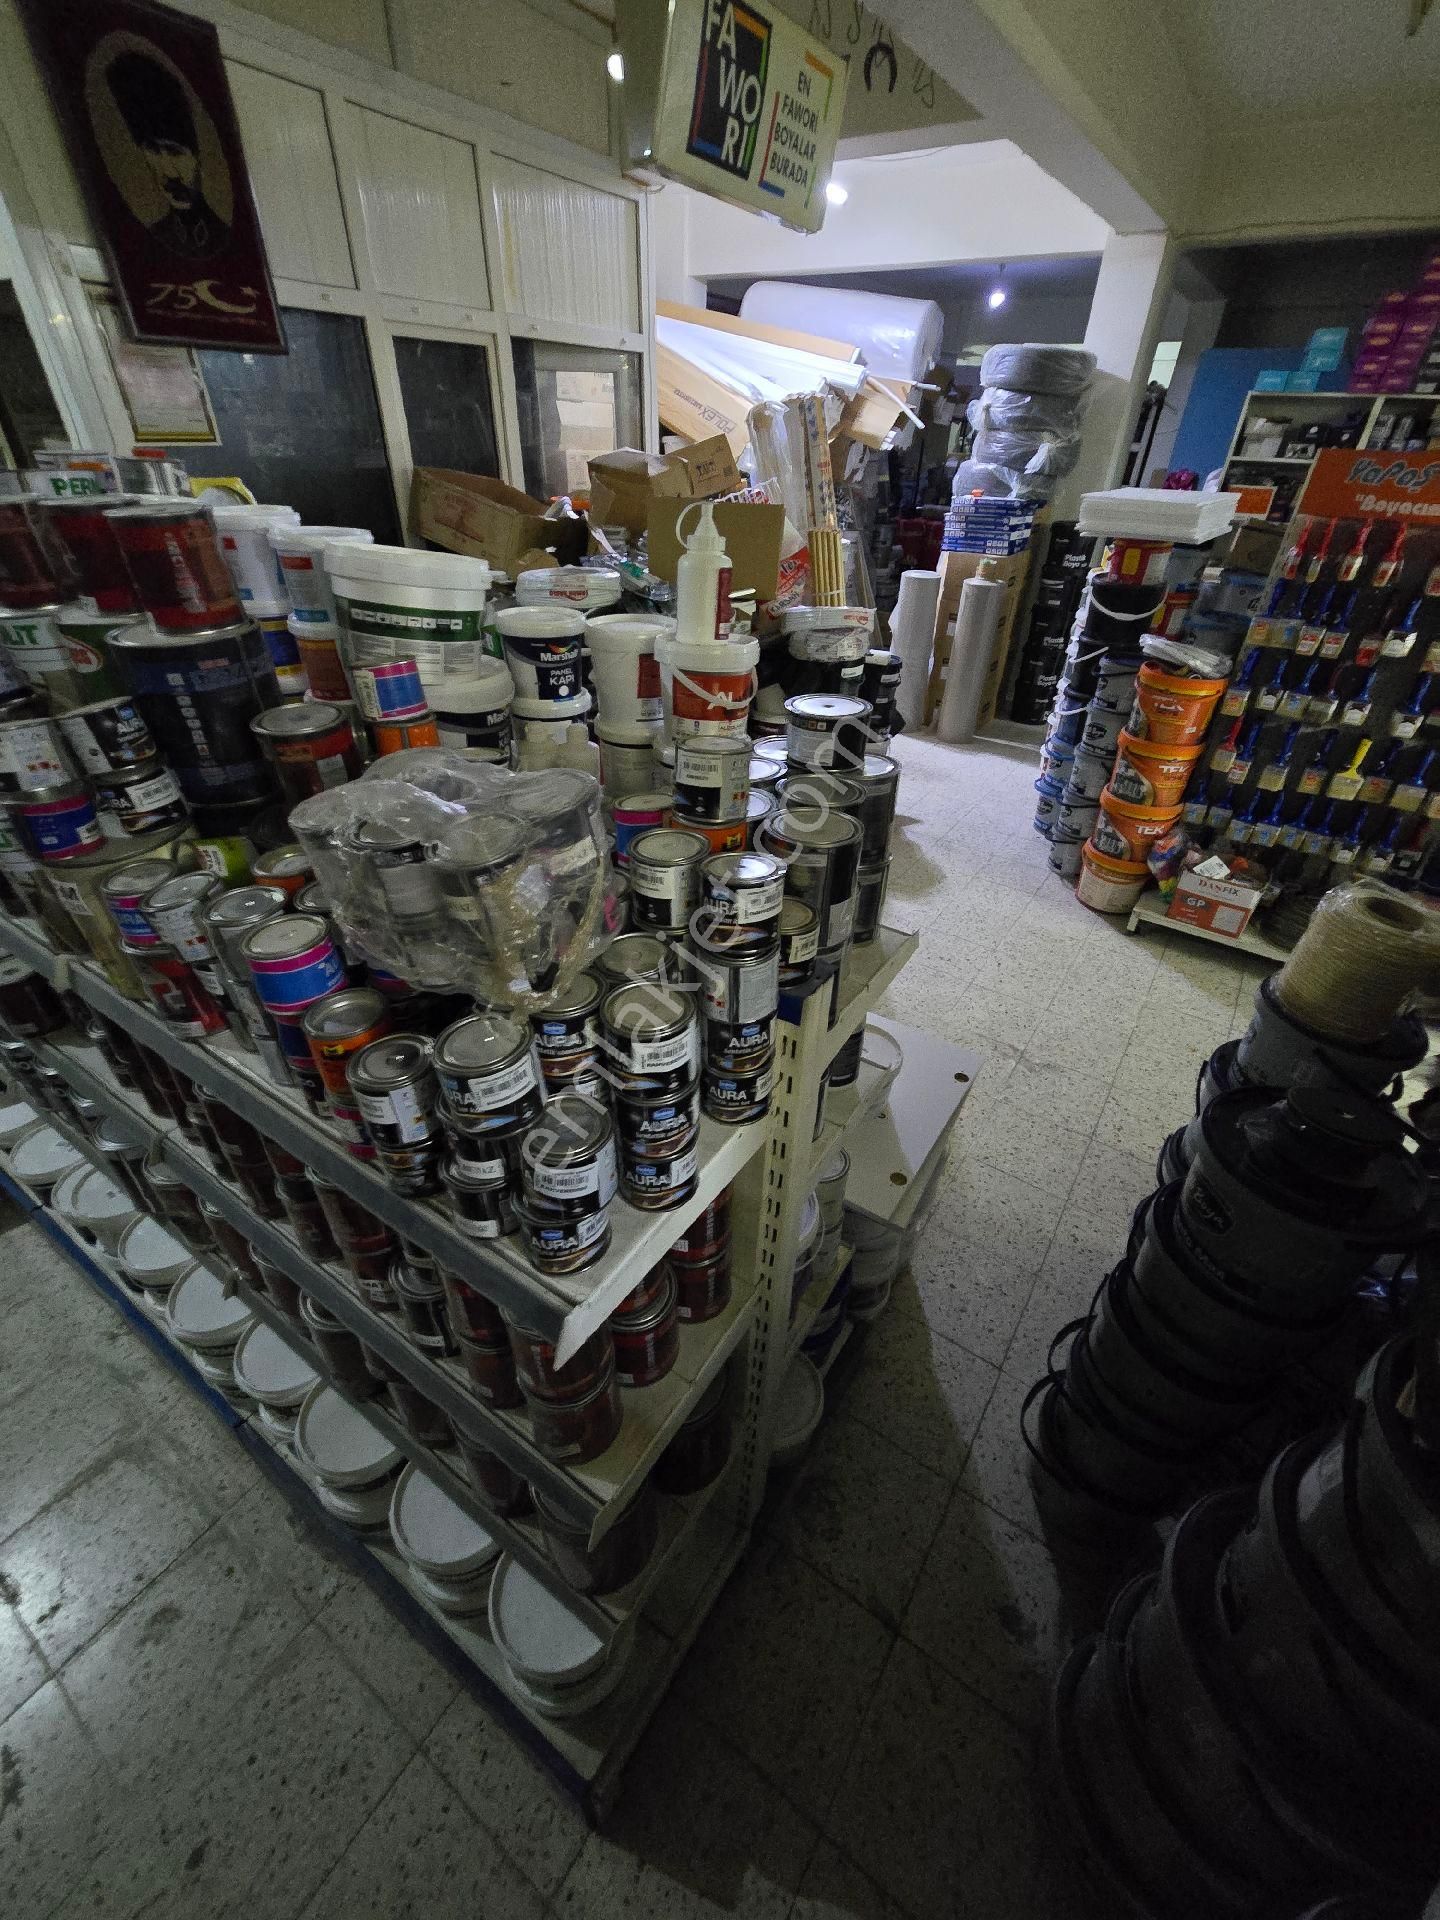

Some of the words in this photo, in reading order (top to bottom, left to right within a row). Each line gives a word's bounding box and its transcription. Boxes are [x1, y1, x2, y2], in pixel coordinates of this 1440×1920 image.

[797, 70, 811, 98] EN
[781, 94, 819, 134] FAWORI
[774, 124, 816, 163] BOYALAR
[770, 153, 808, 188] BURADA
[147, 281, 200, 308] 75
[549, 674, 576, 687] KAPI
[1135, 825, 1165, 834] TEK
[1186, 897, 1207, 908] GP
[729, 1032, 769, 1050] AURA
[708, 1085, 747, 1102] AURA
[641, 1113, 689, 1133] AURA
[624, 1171, 673, 1187] AURA
[531, 1236, 580, 1250] AURA
